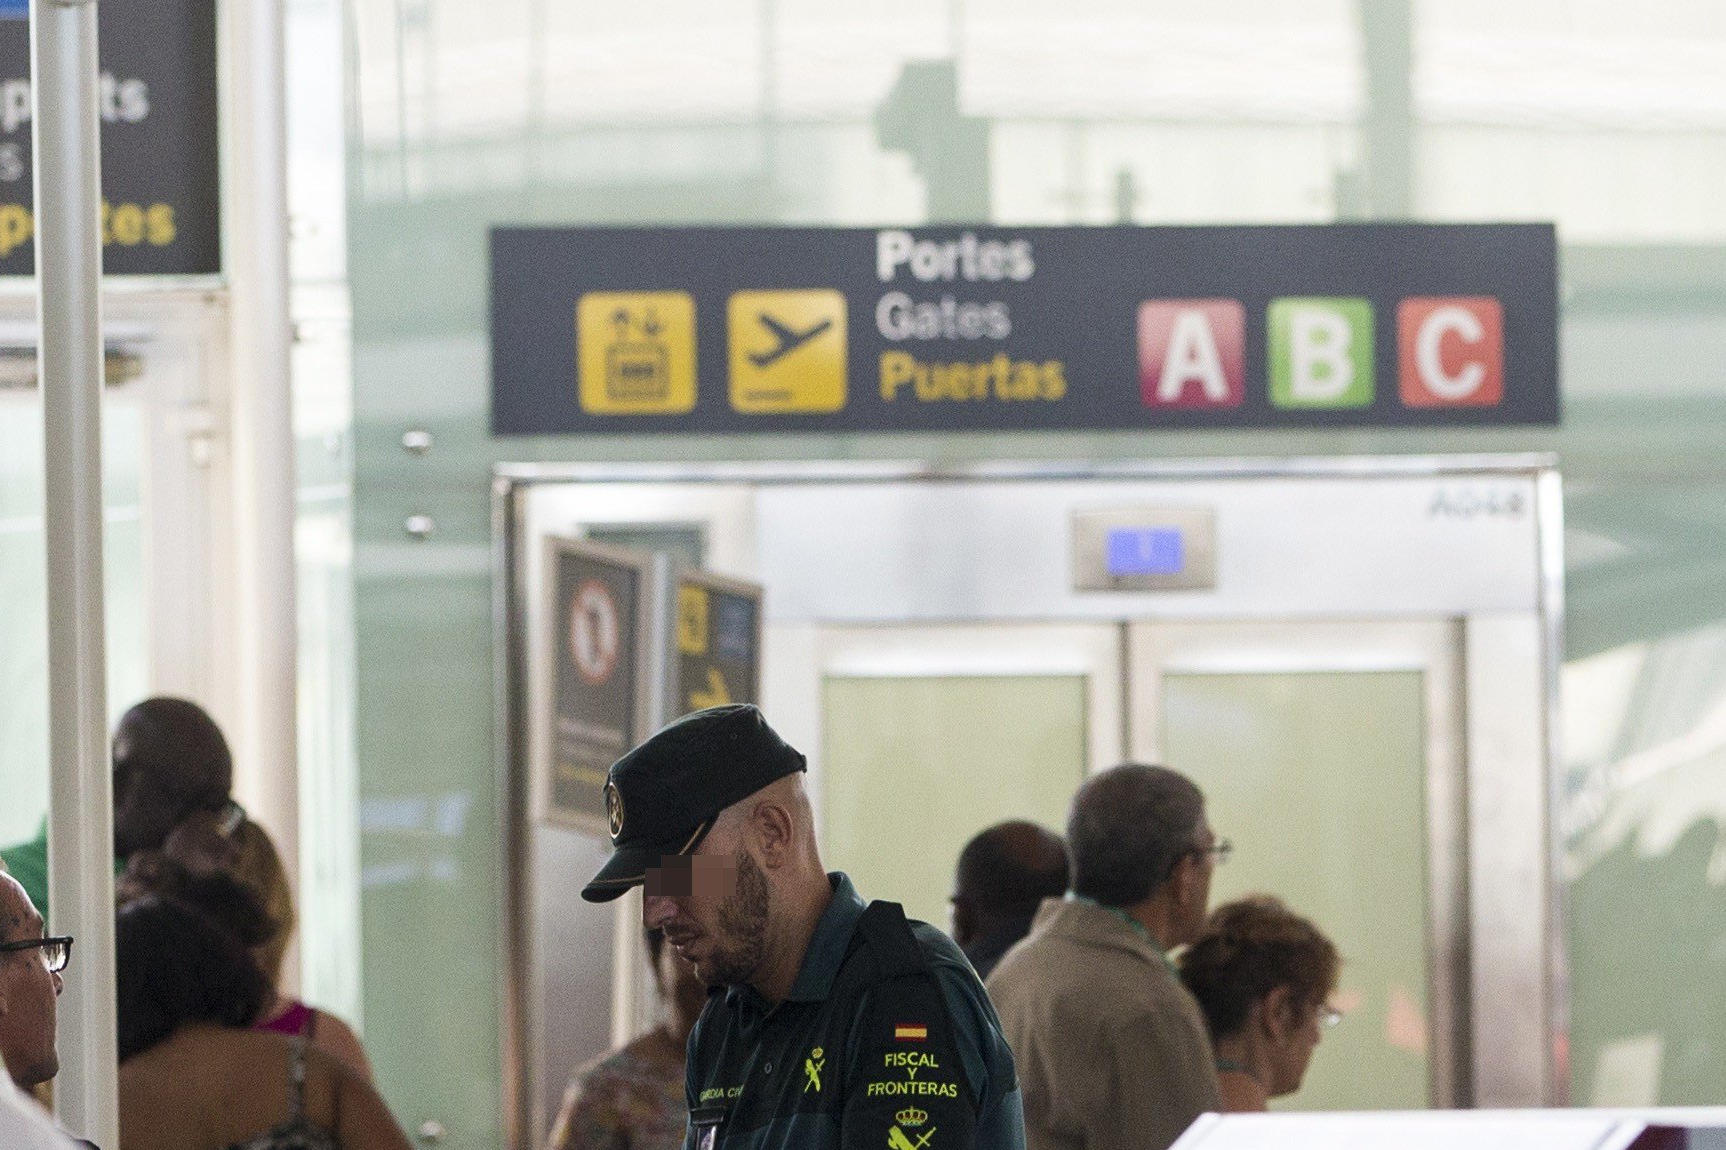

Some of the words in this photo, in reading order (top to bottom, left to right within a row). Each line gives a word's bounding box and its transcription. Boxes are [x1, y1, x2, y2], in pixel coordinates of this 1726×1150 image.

[876, 231, 1035, 281] Portes
[876, 291, 1011, 341] Gates
[879, 351, 1067, 400] Puertas
[1156, 309, 1229, 400] A
[1290, 306, 1353, 399] B
[1416, 305, 1486, 399] C
[885, 1051, 939, 1068] FISCAL
[907, 1067, 918, 1080] Y
[867, 1081, 958, 1098] FRONTERAS
